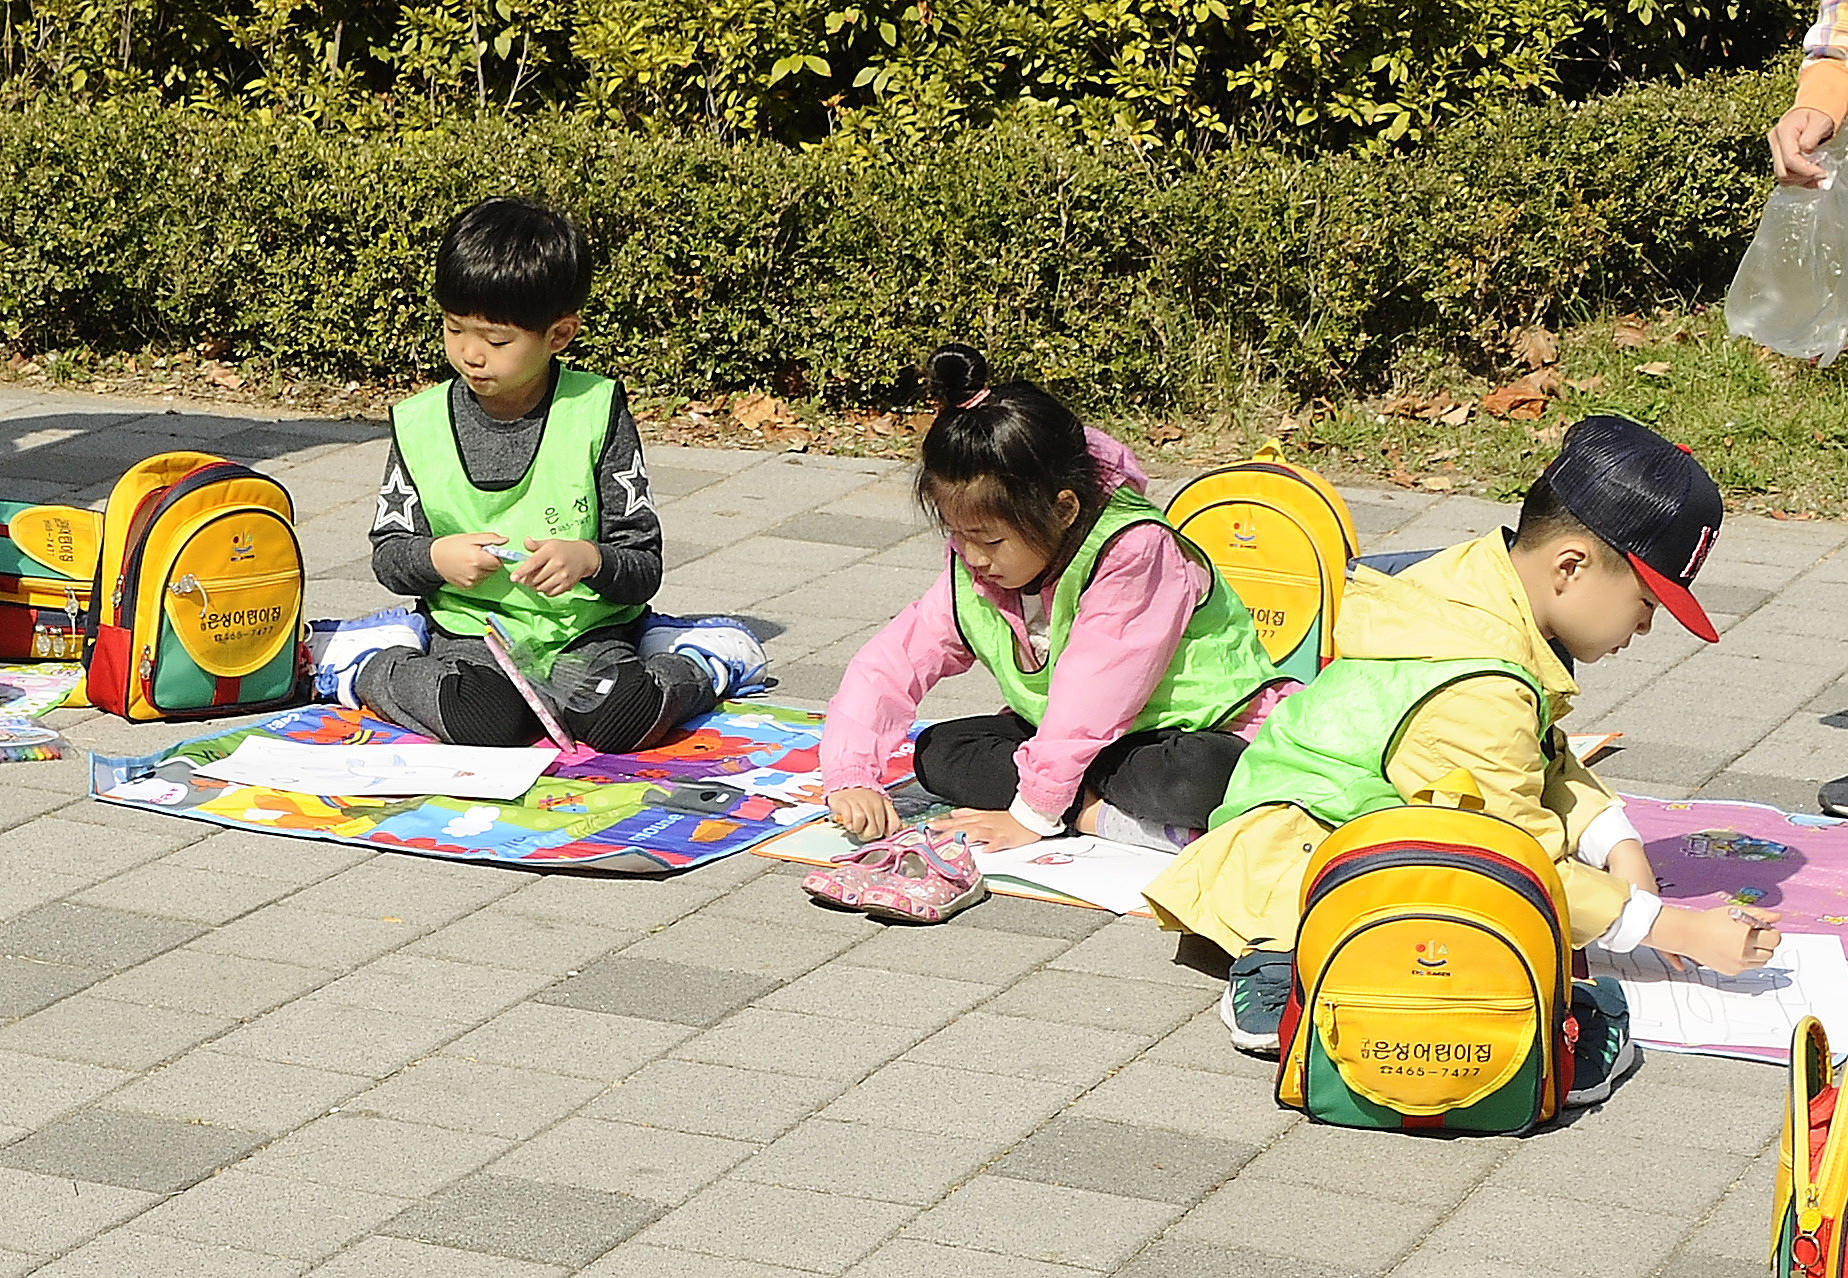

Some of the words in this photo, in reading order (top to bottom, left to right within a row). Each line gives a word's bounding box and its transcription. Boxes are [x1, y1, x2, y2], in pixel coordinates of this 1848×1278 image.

[544, 507, 559, 525] 은
[572, 495, 589, 513] 성
[207, 605, 281, 630] 은성어린이집
[628, 814, 685, 842] mouse
[1372, 1041, 1492, 1063] 은성어린이집
[1395, 1065, 1481, 1078] 465-7477
